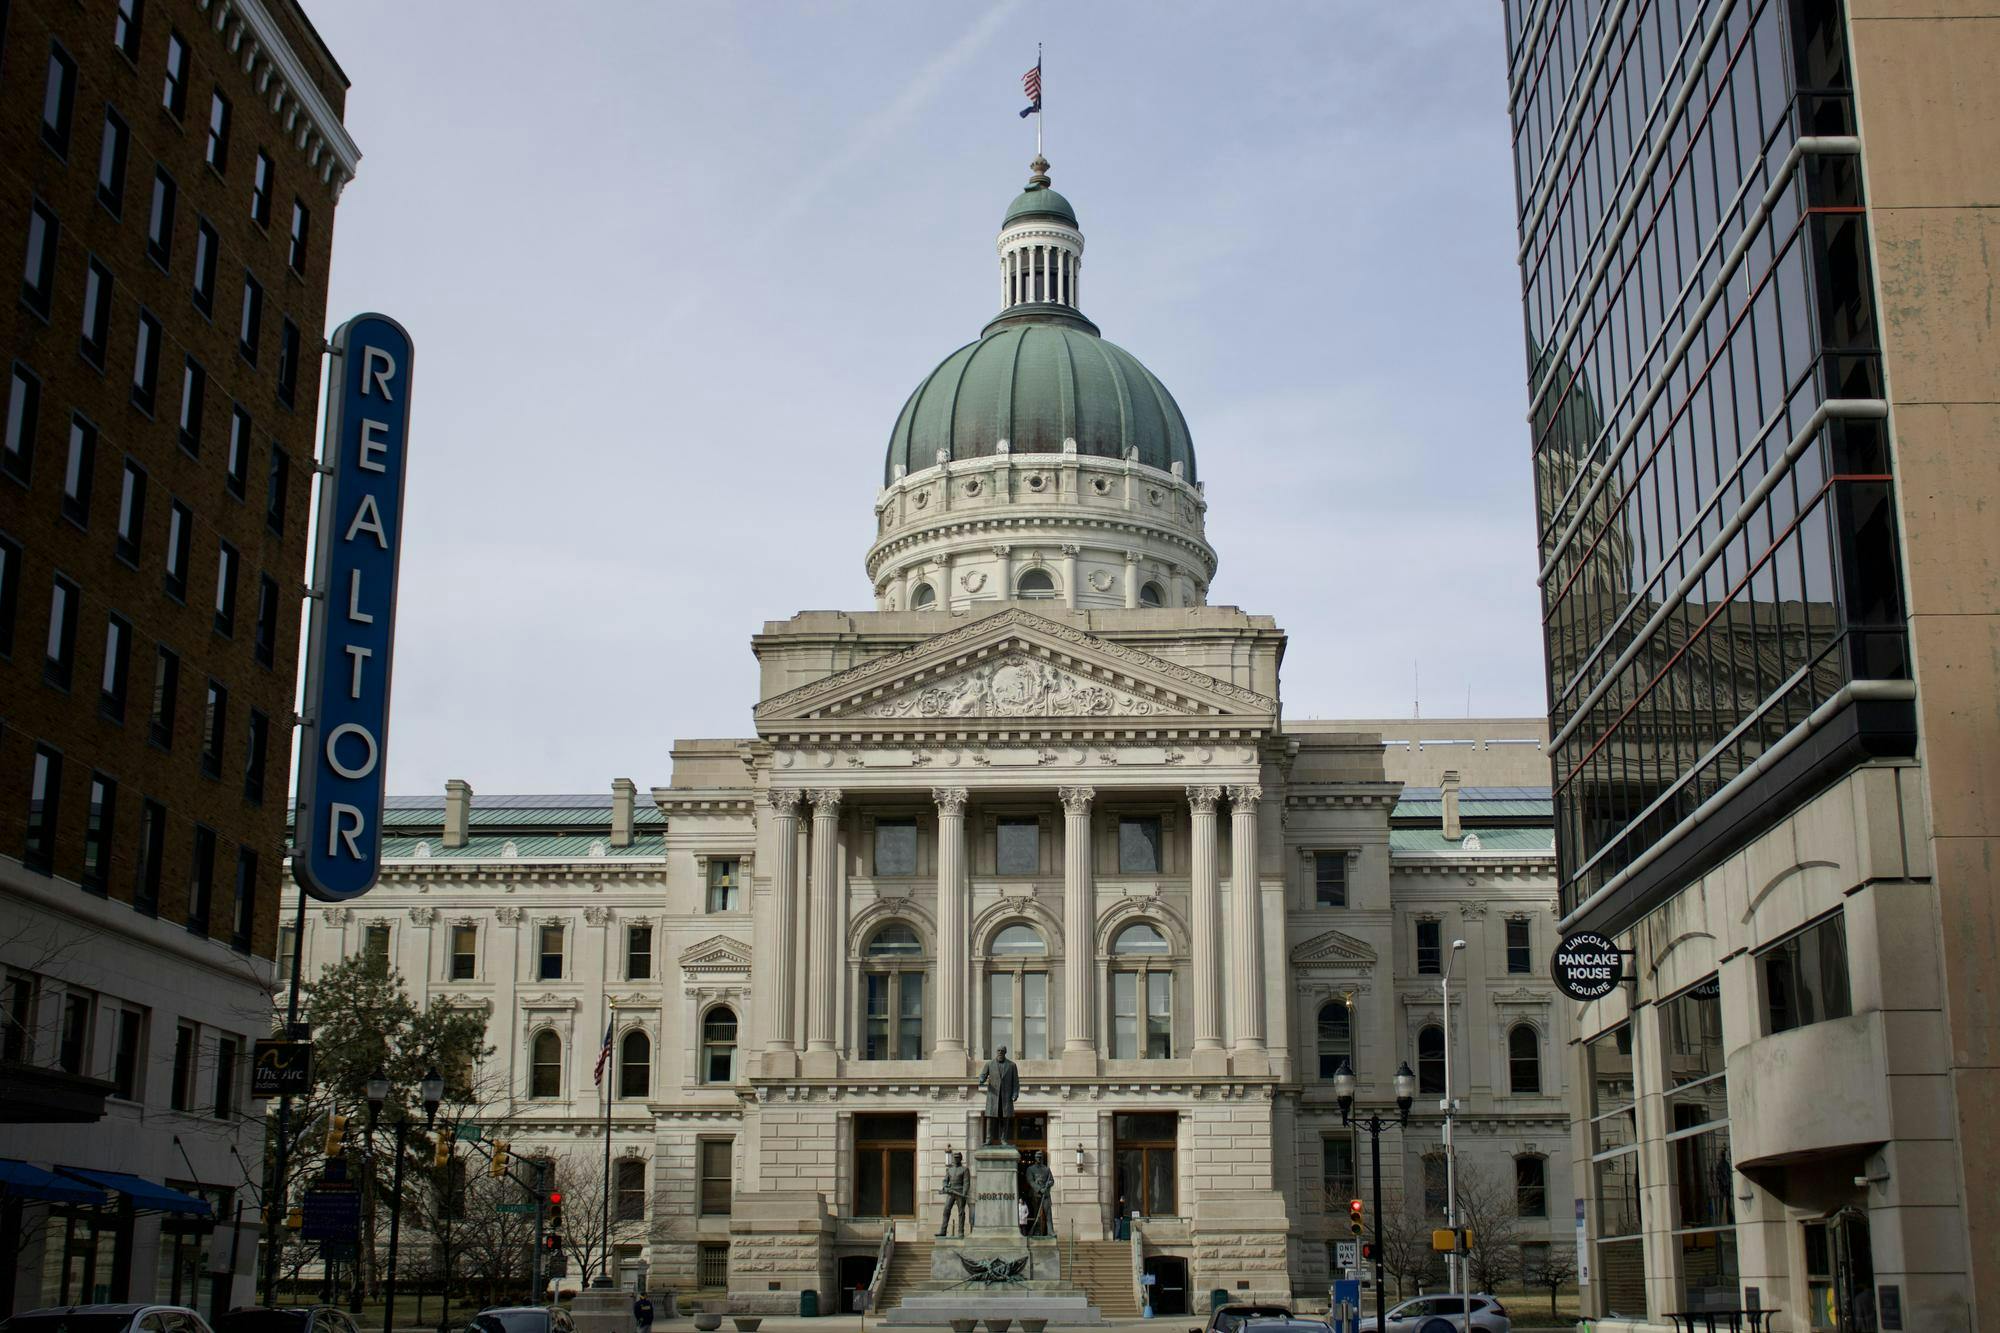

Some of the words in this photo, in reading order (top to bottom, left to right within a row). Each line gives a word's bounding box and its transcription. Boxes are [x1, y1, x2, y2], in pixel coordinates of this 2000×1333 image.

[1565, 935, 1610, 951] LINCOLN
[1558, 953, 1619, 966] PANCAKE
[1567, 967, 1611, 979] HOUSE
[1569, 981, 1611, 996] SQUARE
[256, 1067, 278, 1080] The
[281, 1068, 304, 1080] Arc
[978, 1192, 1015, 1200] MORTON
